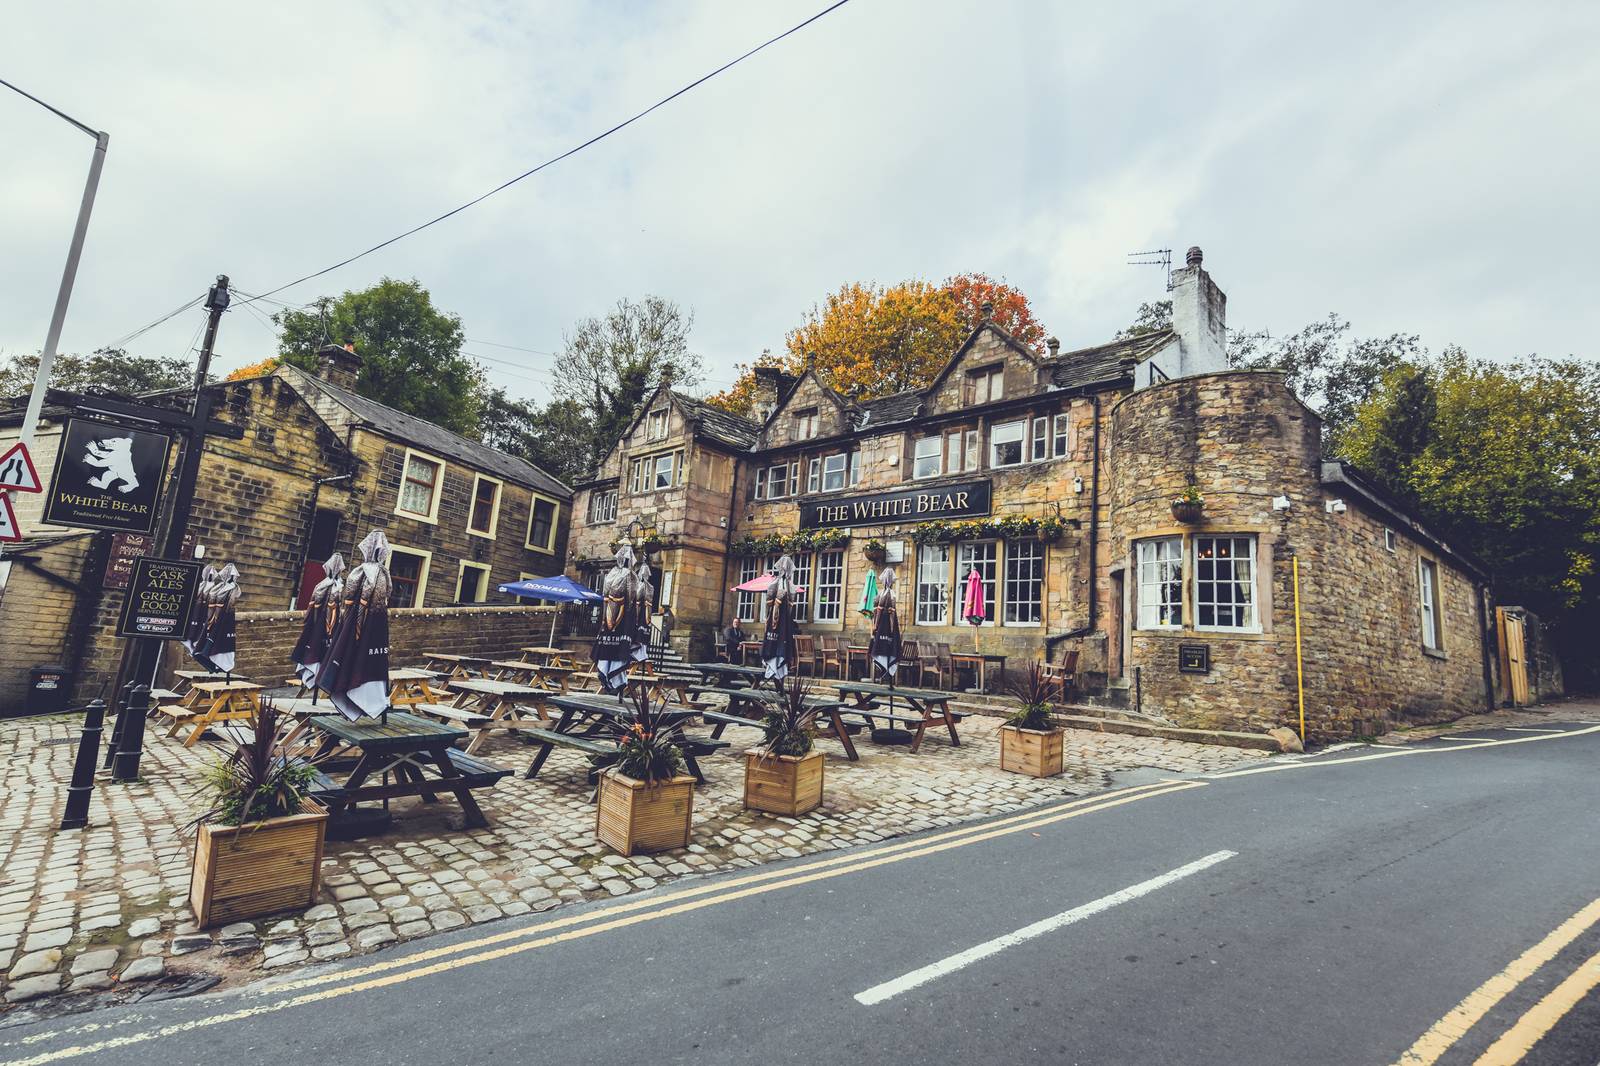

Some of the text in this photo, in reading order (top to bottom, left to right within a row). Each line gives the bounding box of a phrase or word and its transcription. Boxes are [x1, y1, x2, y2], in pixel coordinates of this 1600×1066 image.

[61, 492, 148, 514] WHITE BEAR
[816, 491, 969, 523] THE WHITE BEAR
[72, 510, 102, 519] Traditional
[149, 563, 189, 573] TRADITIONAL
[148, 568, 187, 581] CASK
[147, 579, 184, 590] ALES
[140, 591, 184, 603] GREAT
[141, 600, 179, 612] FOOD
